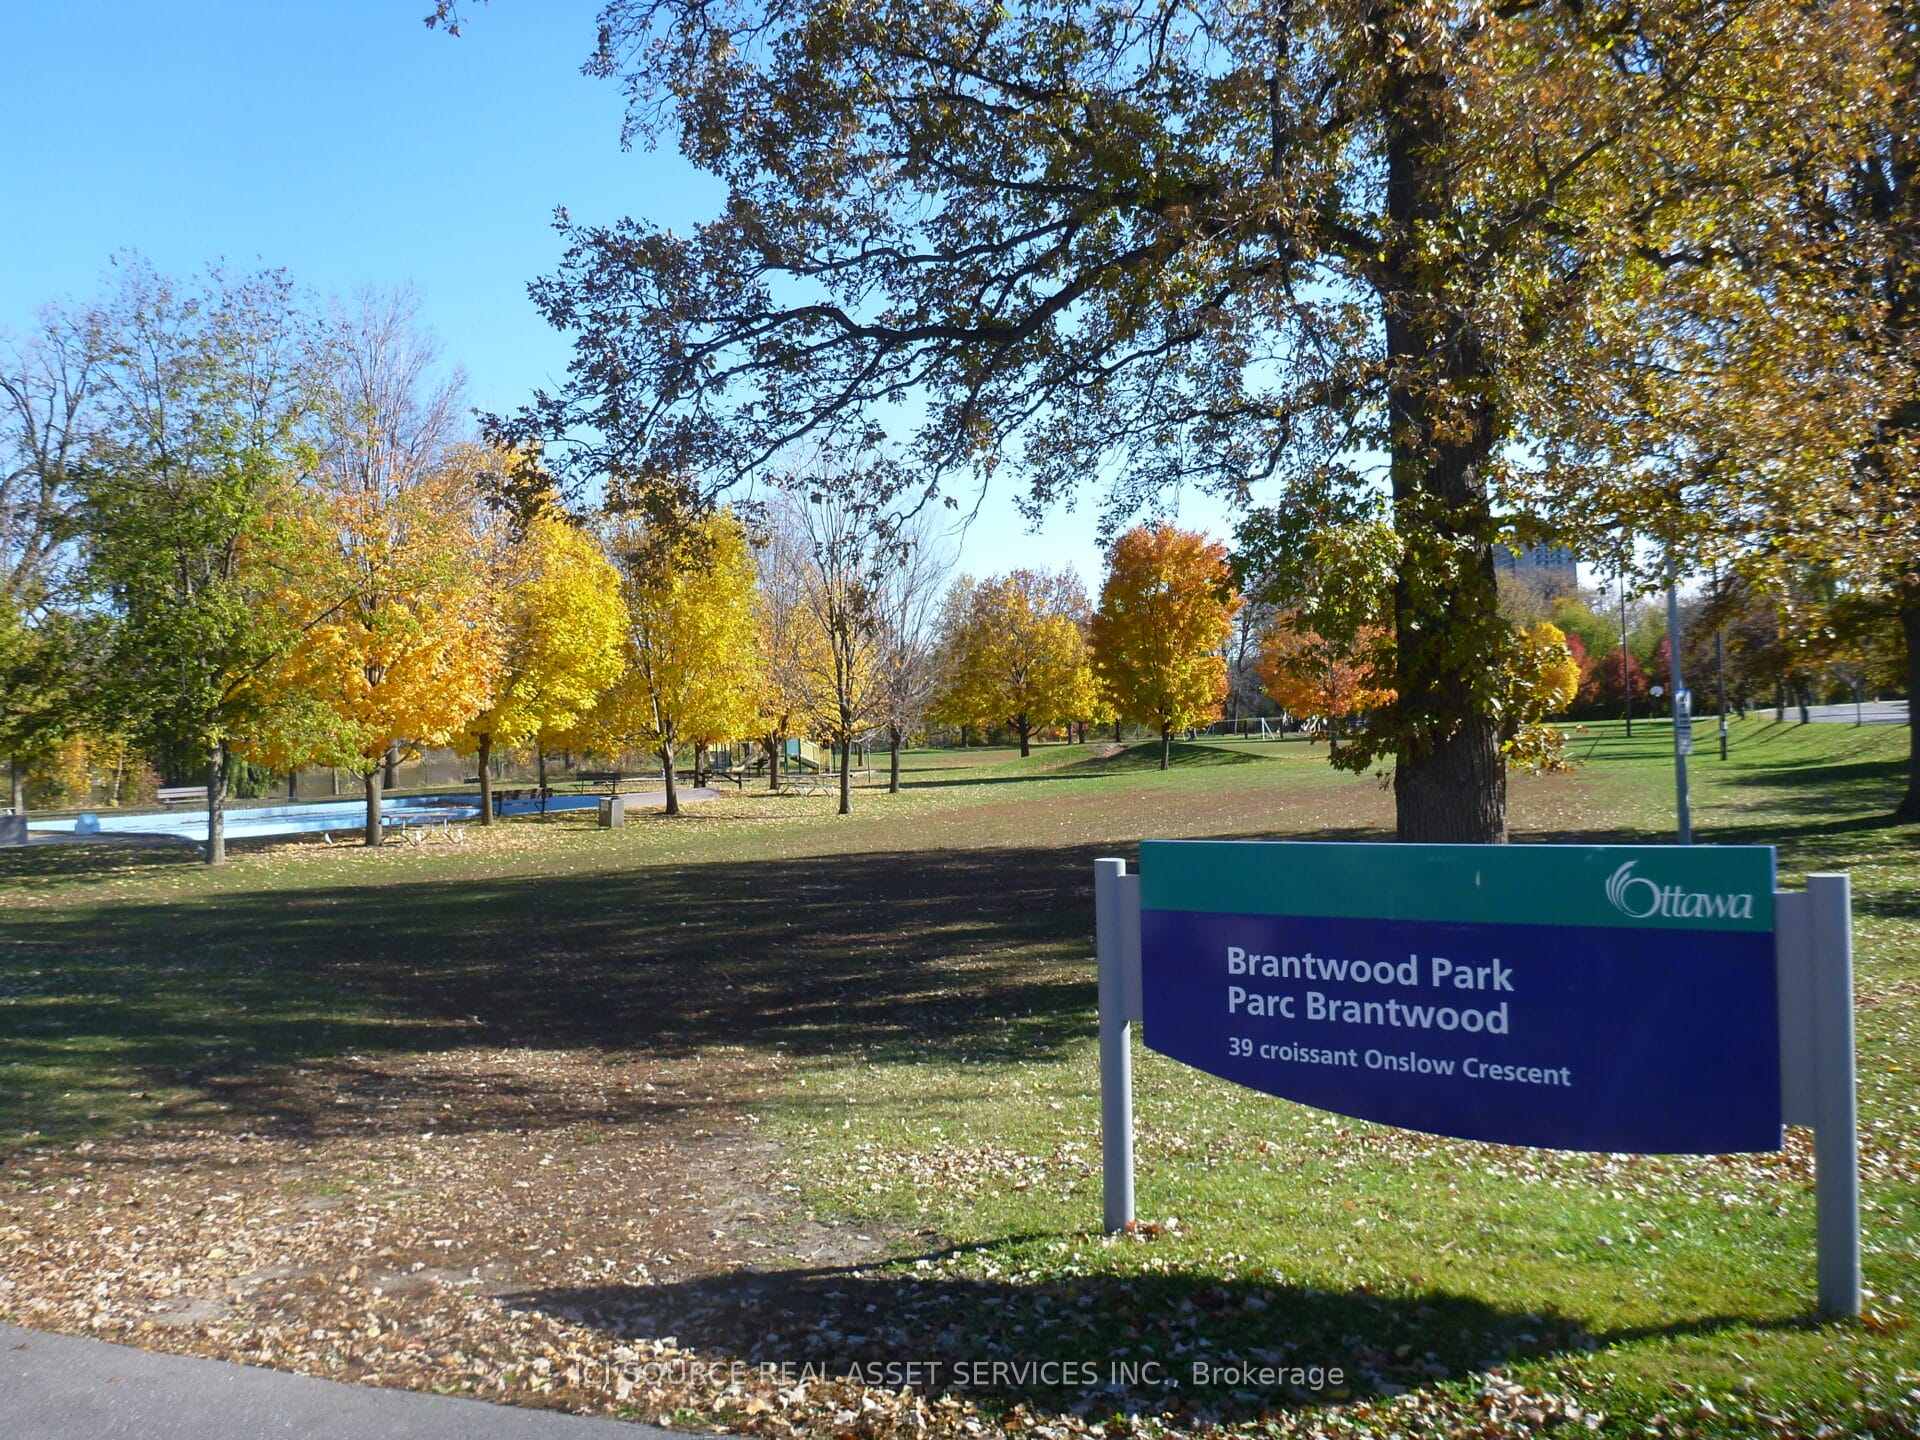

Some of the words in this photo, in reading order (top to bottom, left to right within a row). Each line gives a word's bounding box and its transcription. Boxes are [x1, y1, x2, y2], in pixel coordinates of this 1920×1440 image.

[1605, 861, 1754, 919] Ottawa
[1226, 946, 1418, 986] Brantwood
[1431, 957, 1515, 993] Park
[1227, 987, 1296, 1020] Parc
[1305, 992, 1510, 1036] Brantwood
[1228, 1036, 1254, 1058] 39
[1259, 1042, 1358, 1068] croissant
[1364, 1049, 1455, 1077] Onslow
[1463, 1057, 1572, 1087] Crescent
